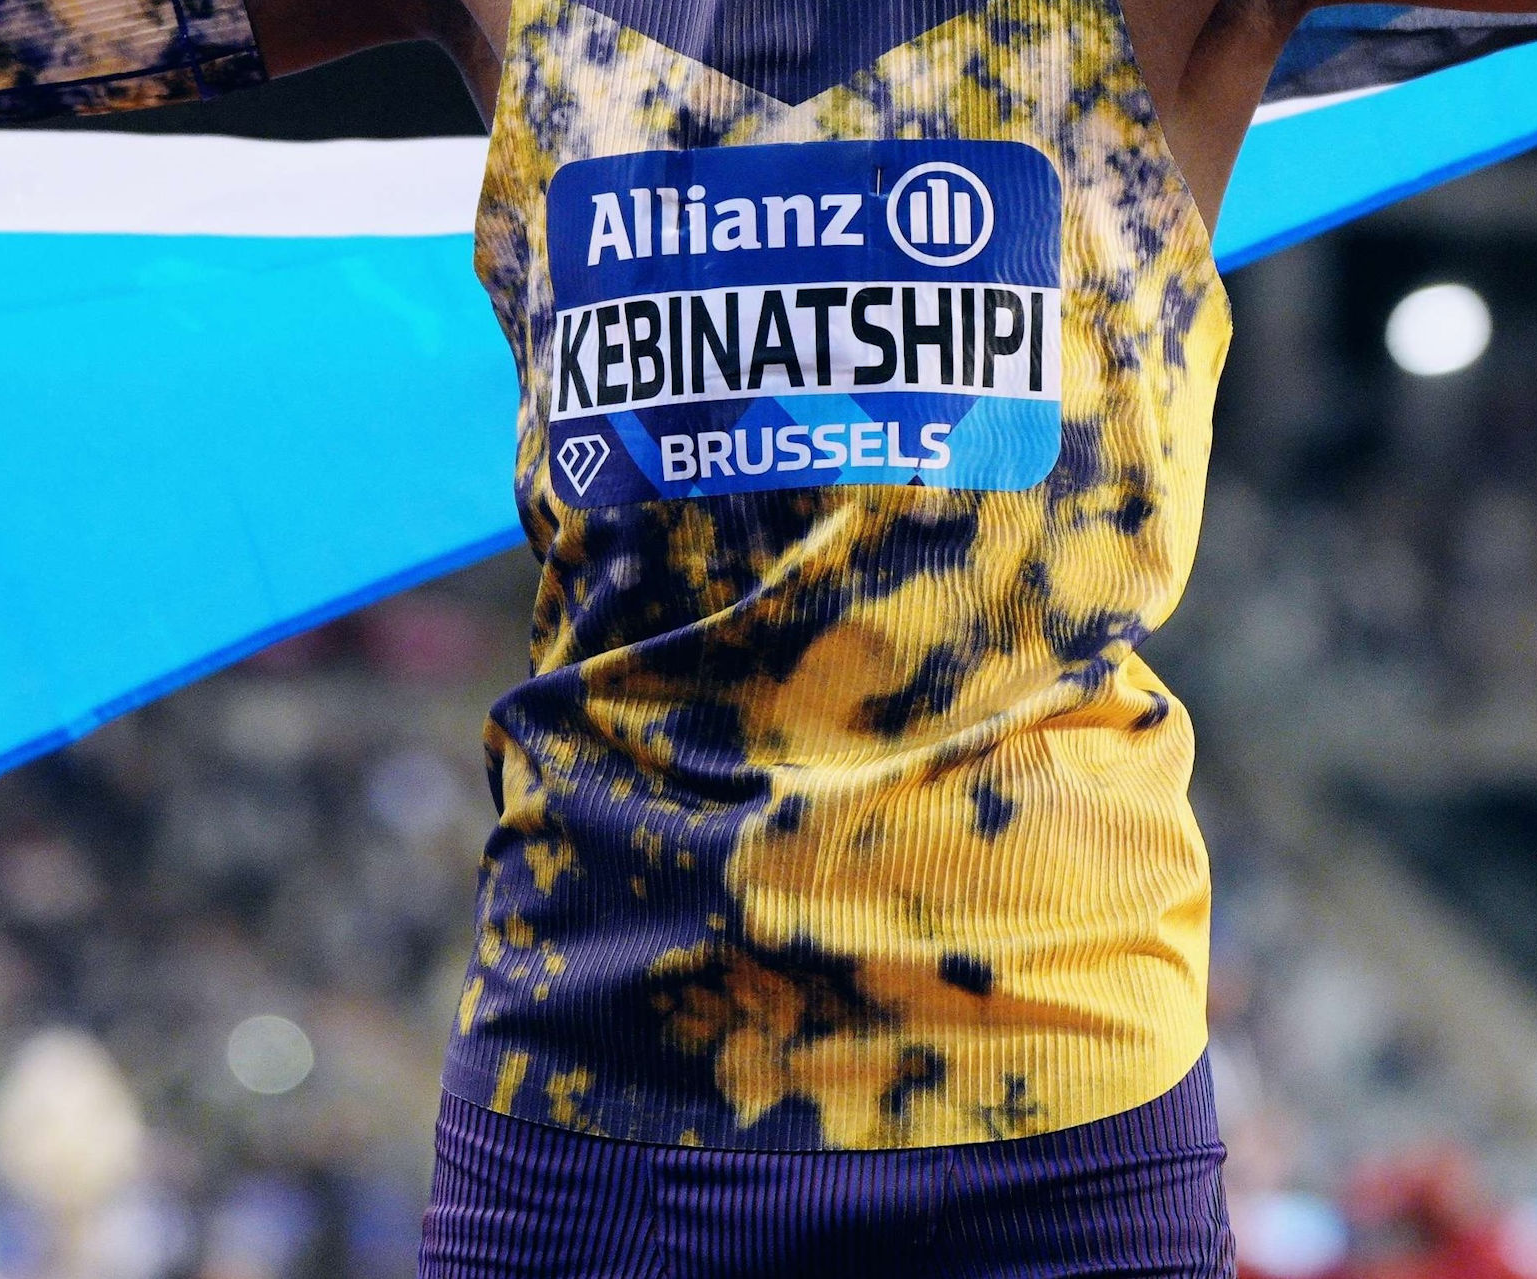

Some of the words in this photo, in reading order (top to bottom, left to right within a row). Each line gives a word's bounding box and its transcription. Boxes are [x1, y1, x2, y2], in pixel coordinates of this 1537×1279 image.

[587, 184, 864, 267] Allianz
[557, 286, 1044, 413] KEBINATSHIPI
[661, 422, 952, 482] BRUSSELS
